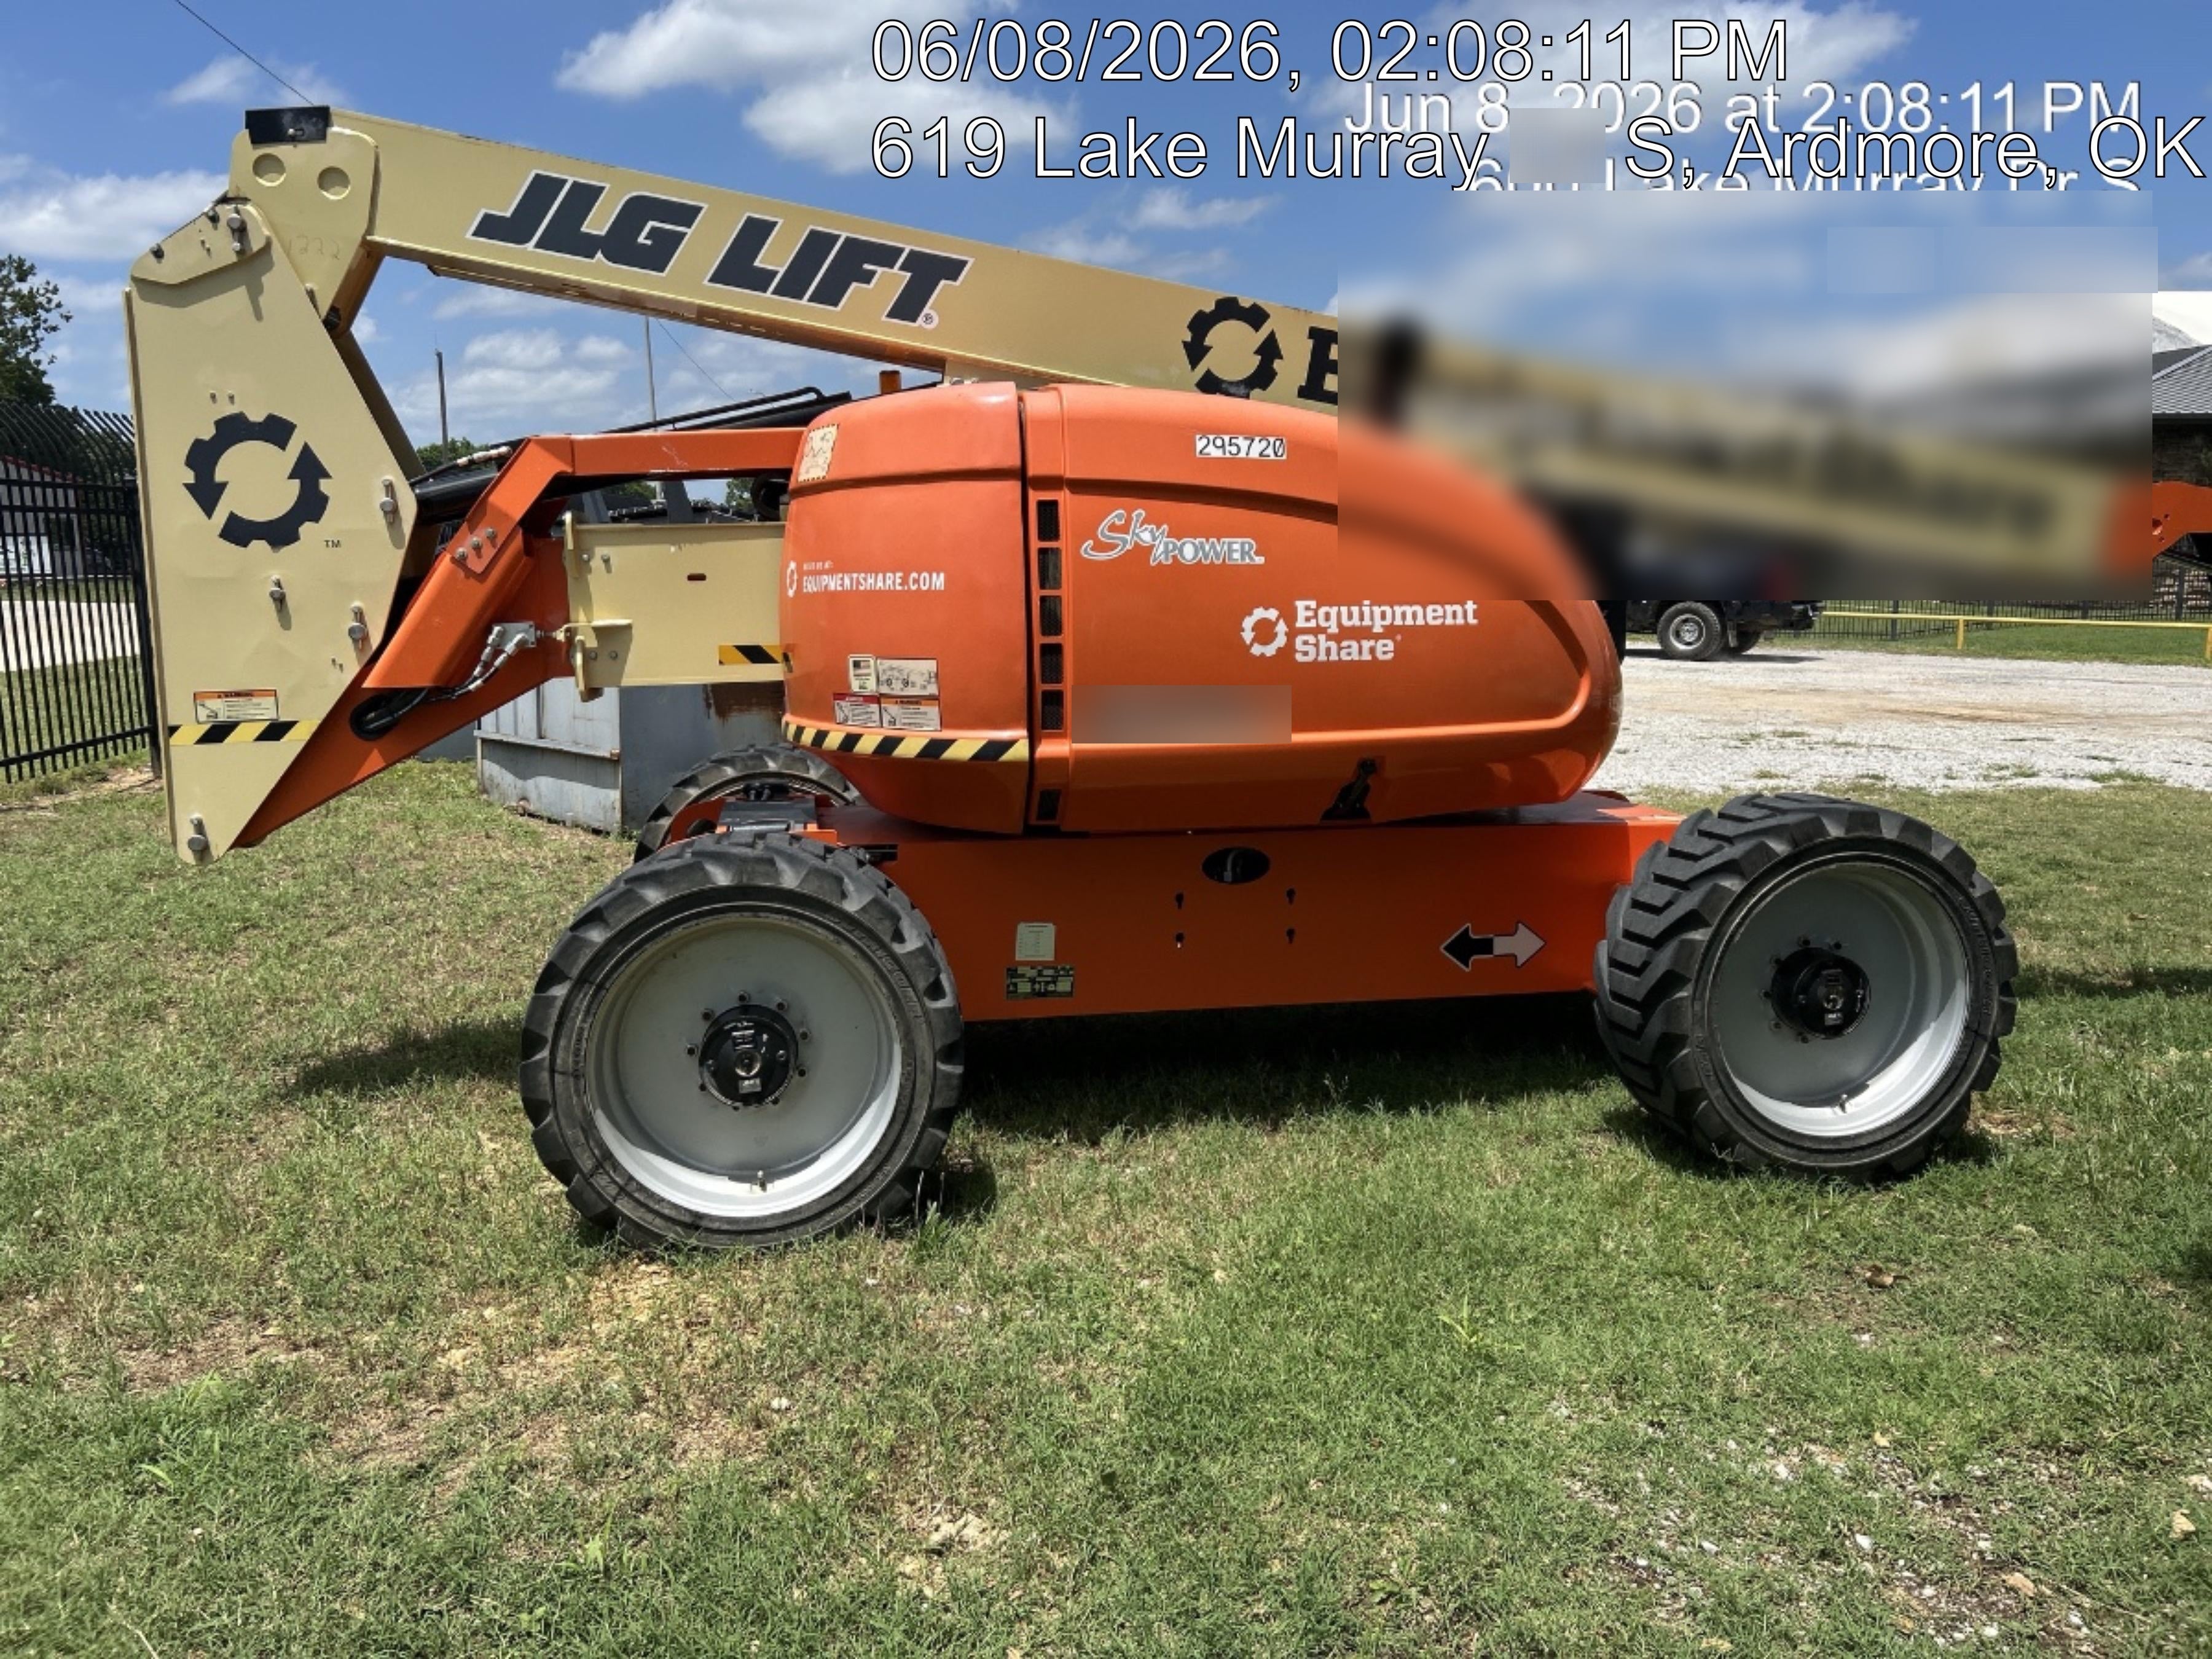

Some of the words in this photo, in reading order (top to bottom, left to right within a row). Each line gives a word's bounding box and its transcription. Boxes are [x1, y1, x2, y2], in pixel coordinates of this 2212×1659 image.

[465, 170, 708, 276] JLG
[1198, 436, 1286, 458] 295720
[802, 573, 944, 593] EQUIPMENTSHARE.COM
[1295, 600, 1478, 632] Equipment
[1295, 635, 1394, 662] Share
